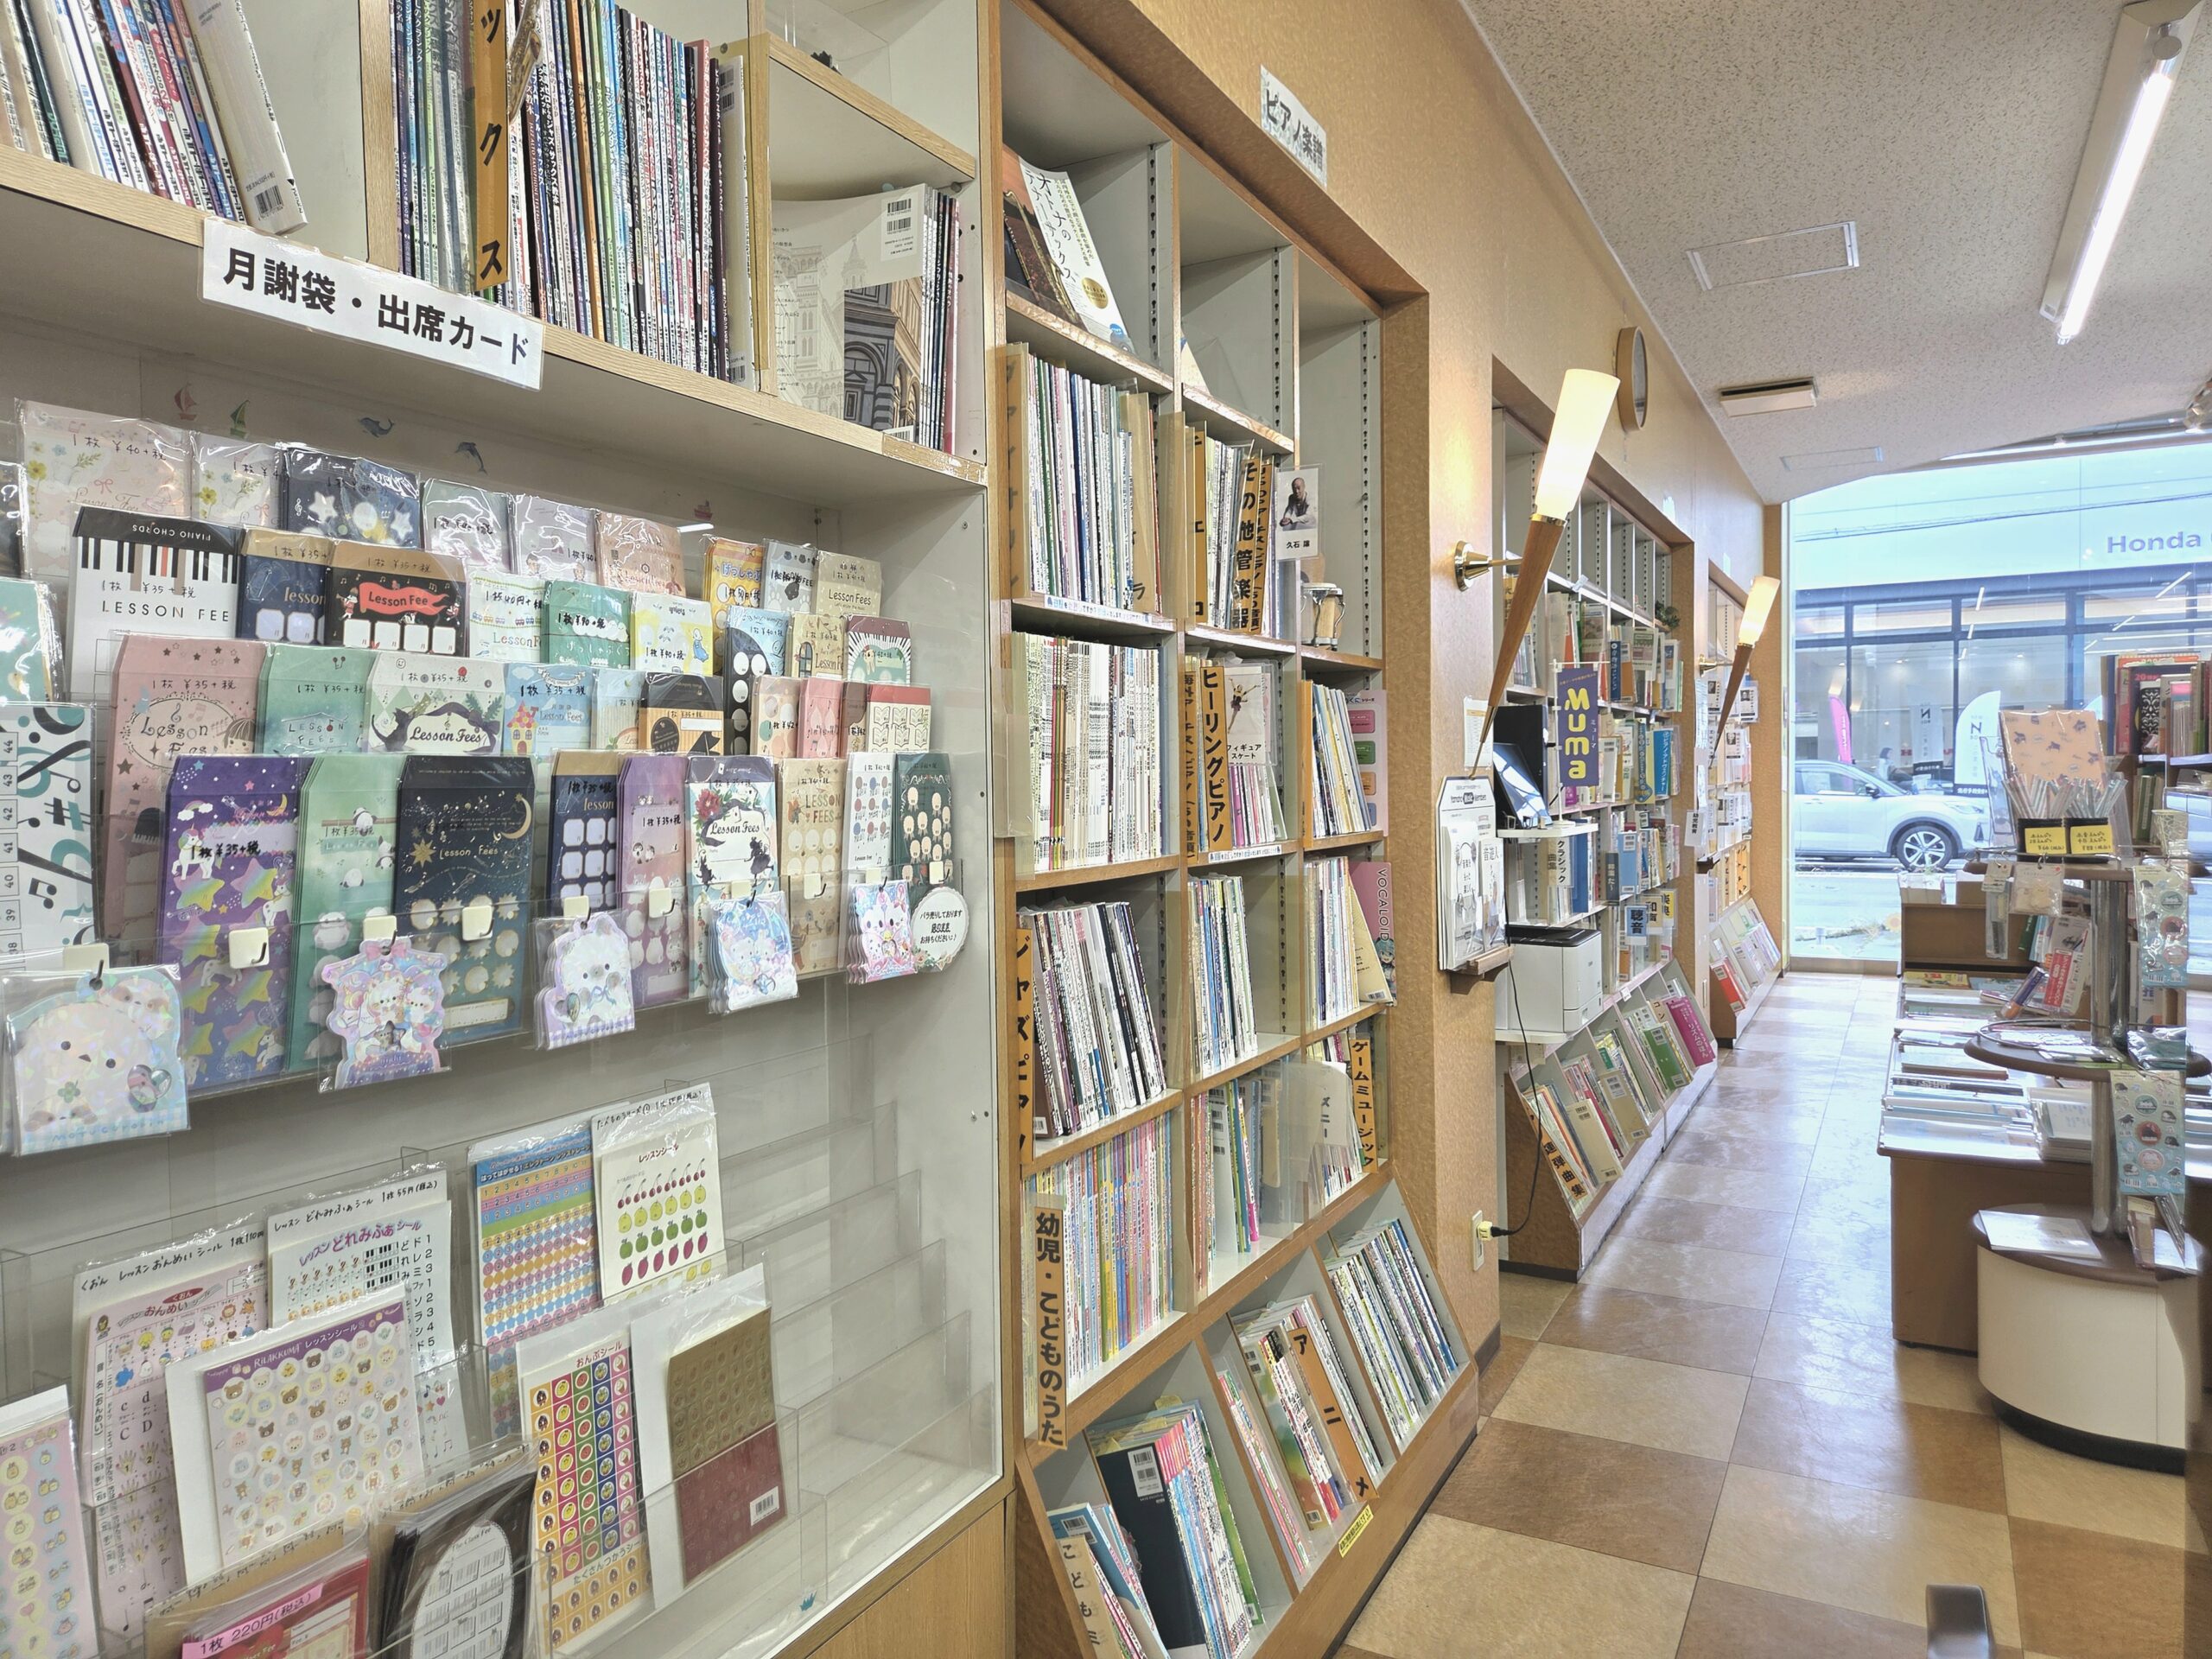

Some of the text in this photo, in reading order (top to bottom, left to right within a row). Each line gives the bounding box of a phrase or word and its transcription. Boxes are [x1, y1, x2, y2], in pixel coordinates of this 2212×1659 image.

[1265, 87, 1324, 172] ピアノ楽譜
[1037, 173, 1071, 241] オトナの
[1026, 171, 1077, 283] テナーサックス
[223, 245, 530, 366] 月謝袋・出席カード
[131, 524, 175, 537] CHORDS
[179, 529, 212, 542] PIANO
[1232, 461, 1258, 628] その他管楽器
[1286, 540, 1300, 549] 久石
[2107, 529, 2202, 555] Honda
[284, 586, 327, 606] lesson
[368, 591, 429, 607] Lesson Fee
[828, 588, 872, 606] Lesson Fees
[102, 600, 231, 622] LESSON FEE
[815, 652, 836, 671] Lesson
[539, 709, 583, 722] Lesson Fees
[140, 715, 209, 738] Lesson
[409, 726, 483, 744] Lesson Fees
[3, 740, 14, 754] 44
[1203, 669, 1226, 842] ヒーリングピアノ
[1226, 743, 1262, 752] フィギュア
[3, 773, 14, 788] 43
[582, 797, 614, 811] lesson
[805, 793, 842, 809] LESSON
[3, 808, 14, 822] 42
[812, 808, 836, 824] FEES
[710, 821, 760, 836] Lesson Fees
[3, 842, 14, 854] 41
[439, 844, 499, 860] Lesson Fees
[1557, 840, 1566, 884] クラシック
[4, 874, 15, 889] 40
[1376, 868, 1390, 943] VOCALOID
[5, 908, 16, 922] 39
[1630, 909, 1644, 934] 聴音
[1351, 1040, 1374, 1169] ゲームミュージック
[639, 1142, 680, 1164] レッスンシール
[299, 1219, 423, 1267] レッスン どれみふぁ シール
[119, 1263, 150, 1281] レッスン
[197, 1241, 223, 1257] シール
[144, 1300, 188, 1317] おんめい
[304, 1322, 358, 1348] レッスンシール
[1036, 1211, 1065, 1447] 幼児・こどものうた
[142, 1390, 150, 1404] d
[120, 1402, 128, 1412] c
[1293, 1333, 1370, 1497] アニメ
[119, 1427, 130, 1440] C
[142, 1419, 153, 1433] D
[200, 1592, 313, 1656] 1枚 220円(税込)
